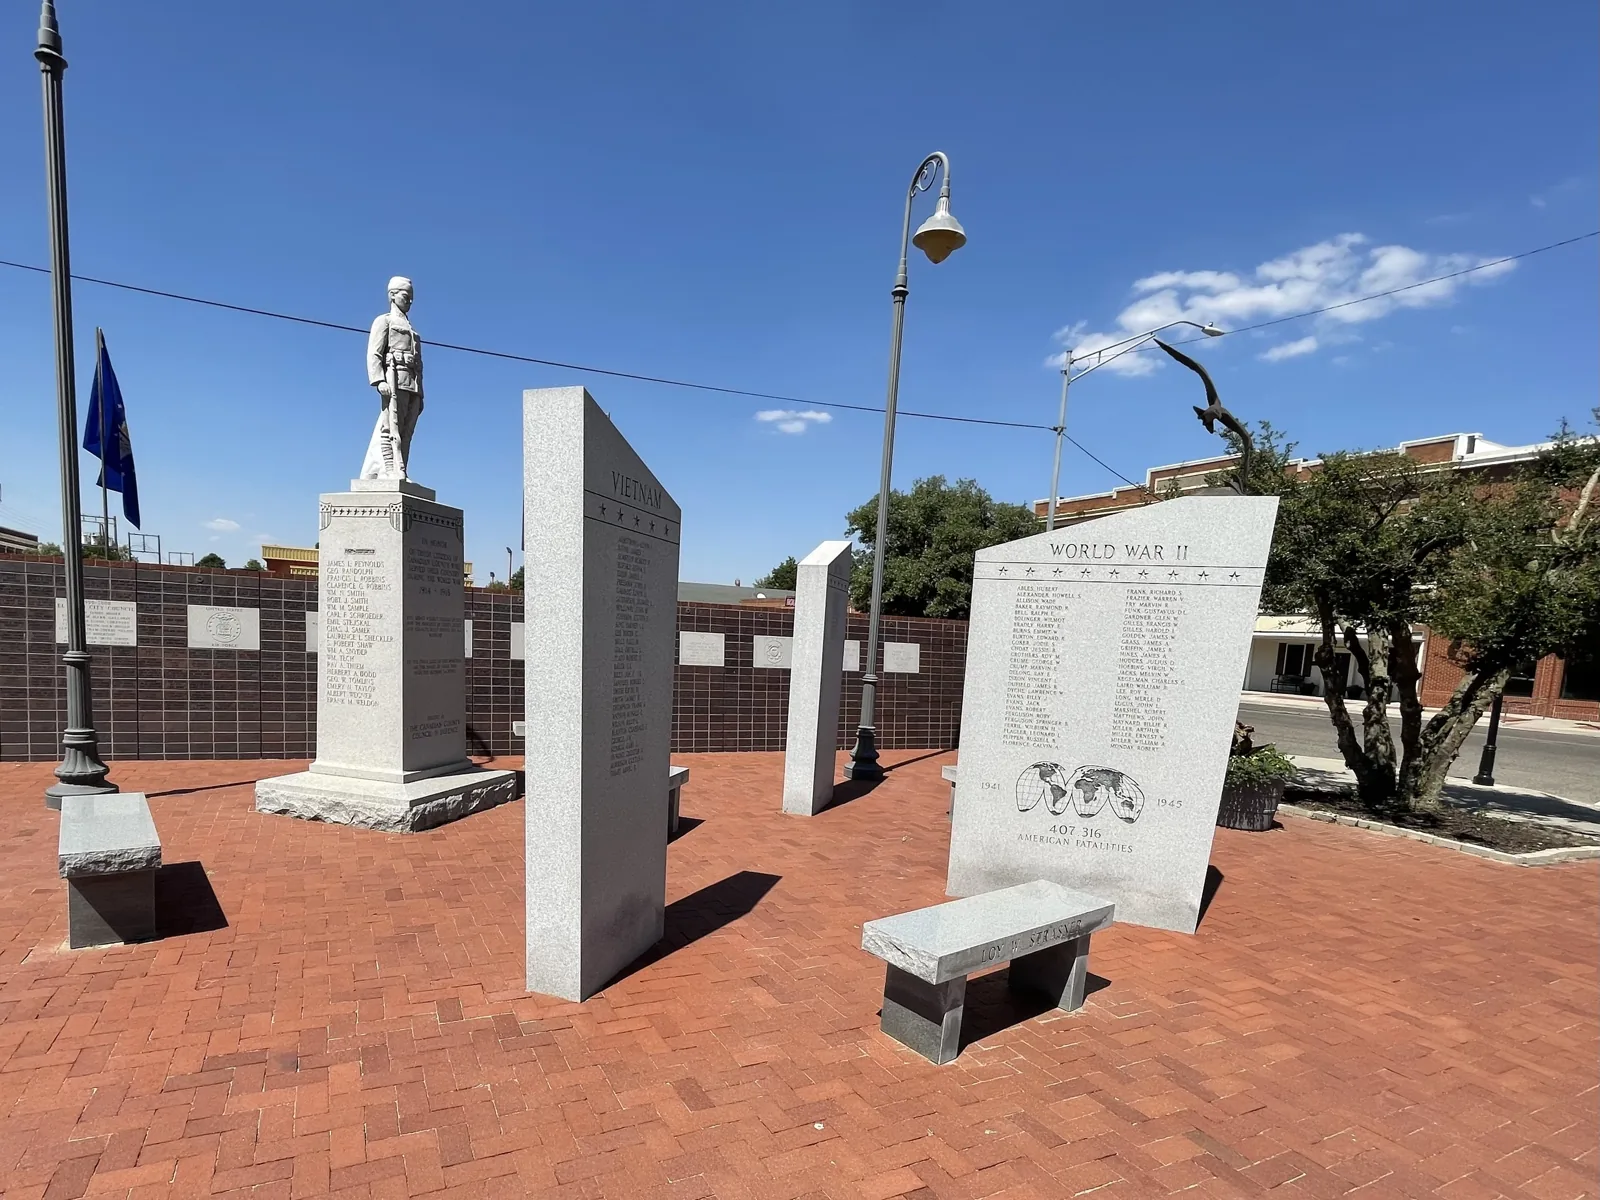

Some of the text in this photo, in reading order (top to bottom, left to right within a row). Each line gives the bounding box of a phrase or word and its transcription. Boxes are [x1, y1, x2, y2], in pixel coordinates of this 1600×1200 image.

[612, 471, 662, 509] VIETNAM
[1050, 544, 1188, 560] WORLD WAR II
[1157, 798, 1182, 808] 1945
[1018, 834, 1133, 852] AMERICAN FATALITIES
